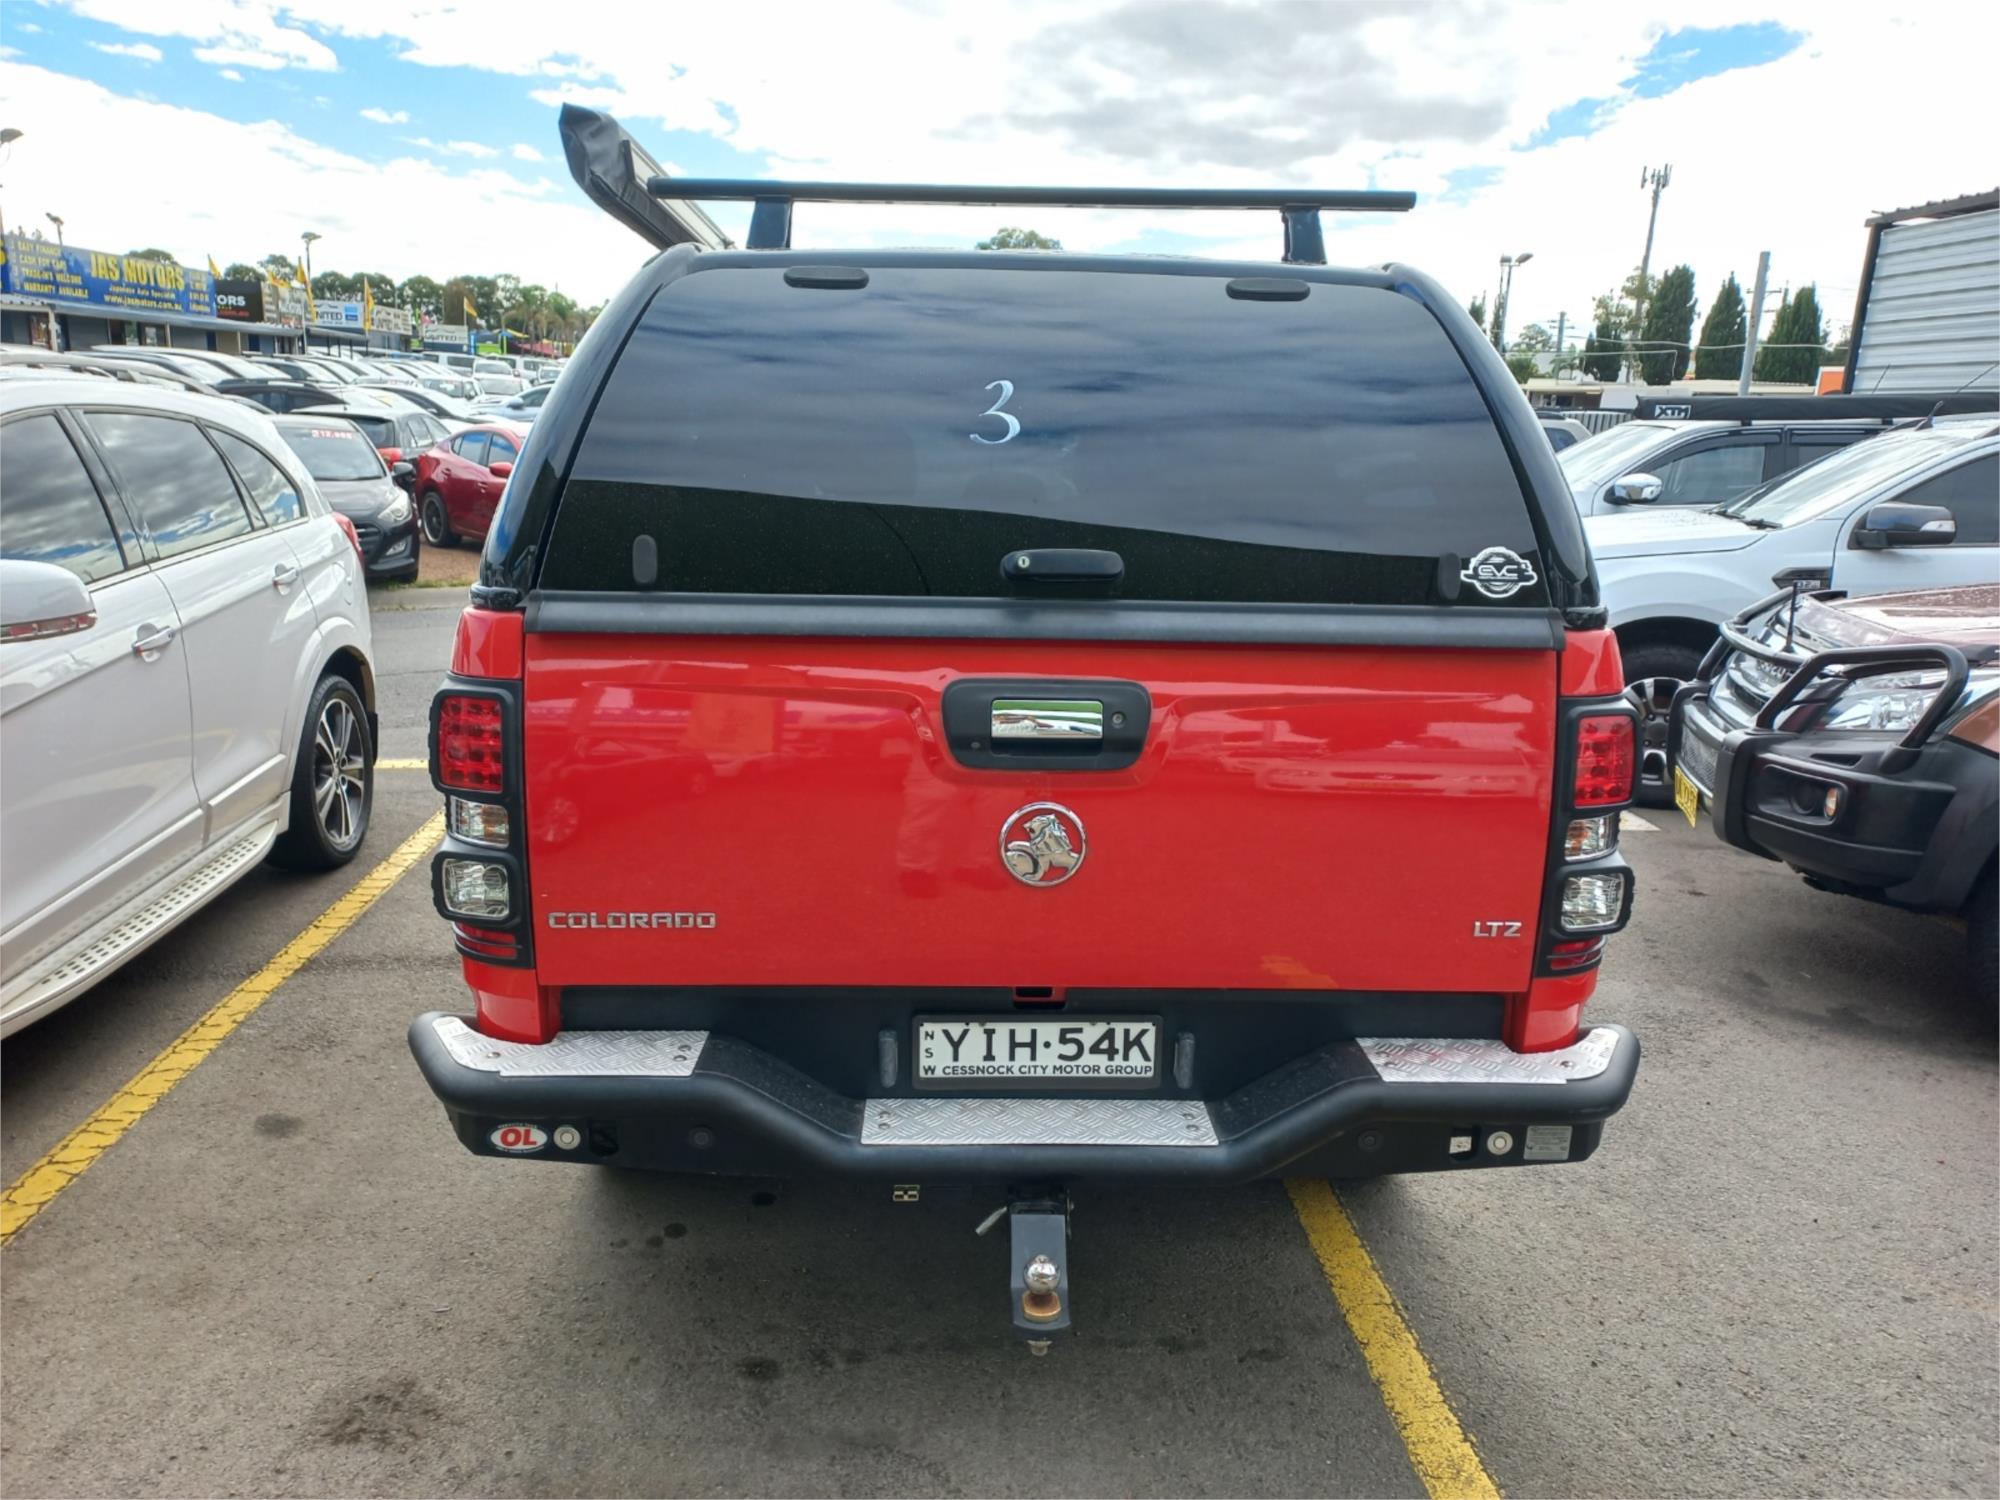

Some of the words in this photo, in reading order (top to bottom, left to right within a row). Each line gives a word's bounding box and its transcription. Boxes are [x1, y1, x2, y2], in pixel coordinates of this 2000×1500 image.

[91, 251, 120, 281] JAS
[123, 258, 185, 291] MOTORS
[214, 294, 247, 308] ORS
[316, 310, 343, 321] NITED
[969, 379, 1021, 445] 3
[1655, 406, 1690, 419] XTM
[548, 911, 717, 929] COLORADO
[1473, 921, 1522, 937] LTZ
[942, 1065, 1014, 1076] CESSNOCK
[1018, 1065, 1048, 1075] CITY
[1052, 1065, 1101, 1075] MOTOR
[1105, 1065, 1153, 1075] GROUP
[500, 1128, 538, 1147] OL
